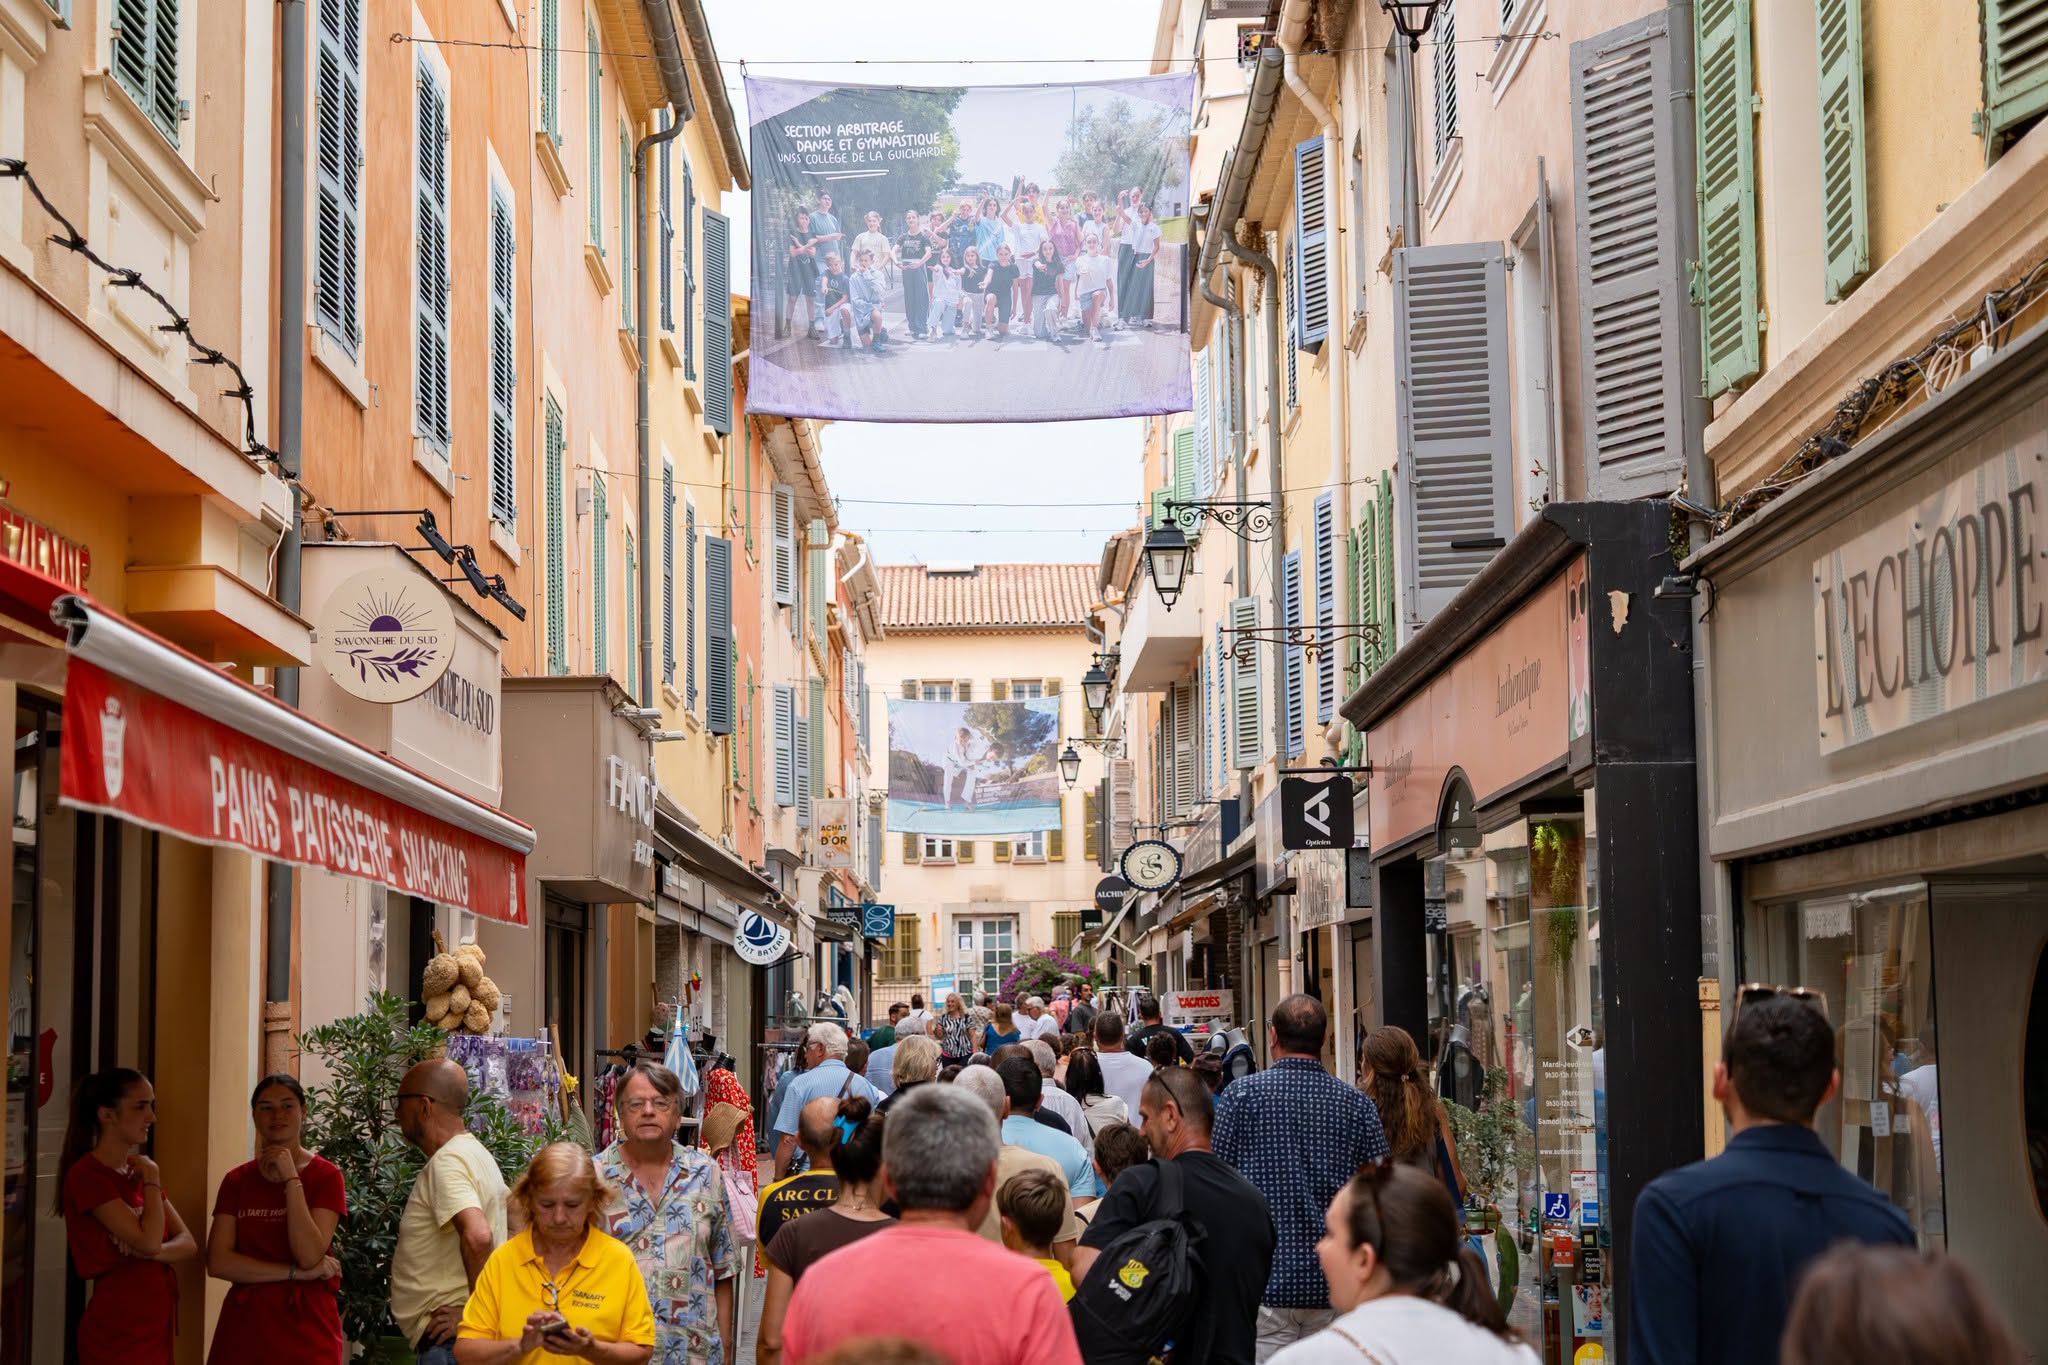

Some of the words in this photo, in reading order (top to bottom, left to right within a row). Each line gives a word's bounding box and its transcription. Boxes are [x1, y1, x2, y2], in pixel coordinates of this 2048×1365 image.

[784, 125, 831, 138] SECTION
[836, 120, 905, 137] ARBITRAGE
[796, 139, 835, 153] DANSE
[838, 138, 853, 151] ET
[856, 132, 942, 150] GYMNASTIQUE
[777, 153, 802, 163] UNSS
[852, 152, 865, 163] DE
[869, 151, 884, 161] LA
[887, 146, 947, 160] GUICHARDE
[1821, 481, 2043, 719] L'ECHOPPE
[334, 636, 397, 646] SAVONNERIE
[399, 636, 415, 645] DU
[416, 636, 438, 645] SUD
[1495, 655, 1542, 719] Authentique
[461, 678, 475, 725] DU
[475, 688, 494, 736] SUD
[209, 755, 282, 853] PAINS
[287, 787, 397, 886] PATISSERIE
[400, 828, 469, 906] SNACKING
[820, 824, 848, 832] ACHAT
[820, 835, 848, 846] D'OR
[1305, 838, 1332, 847] Opticien
[735, 935, 755, 955] PETIT
[757, 934, 786, 957] BATEAU
[773, 1189, 811, 1202] ARC
[247, 1208, 268, 1217] TARTE
[572, 1289, 606, 1301] SANARY
